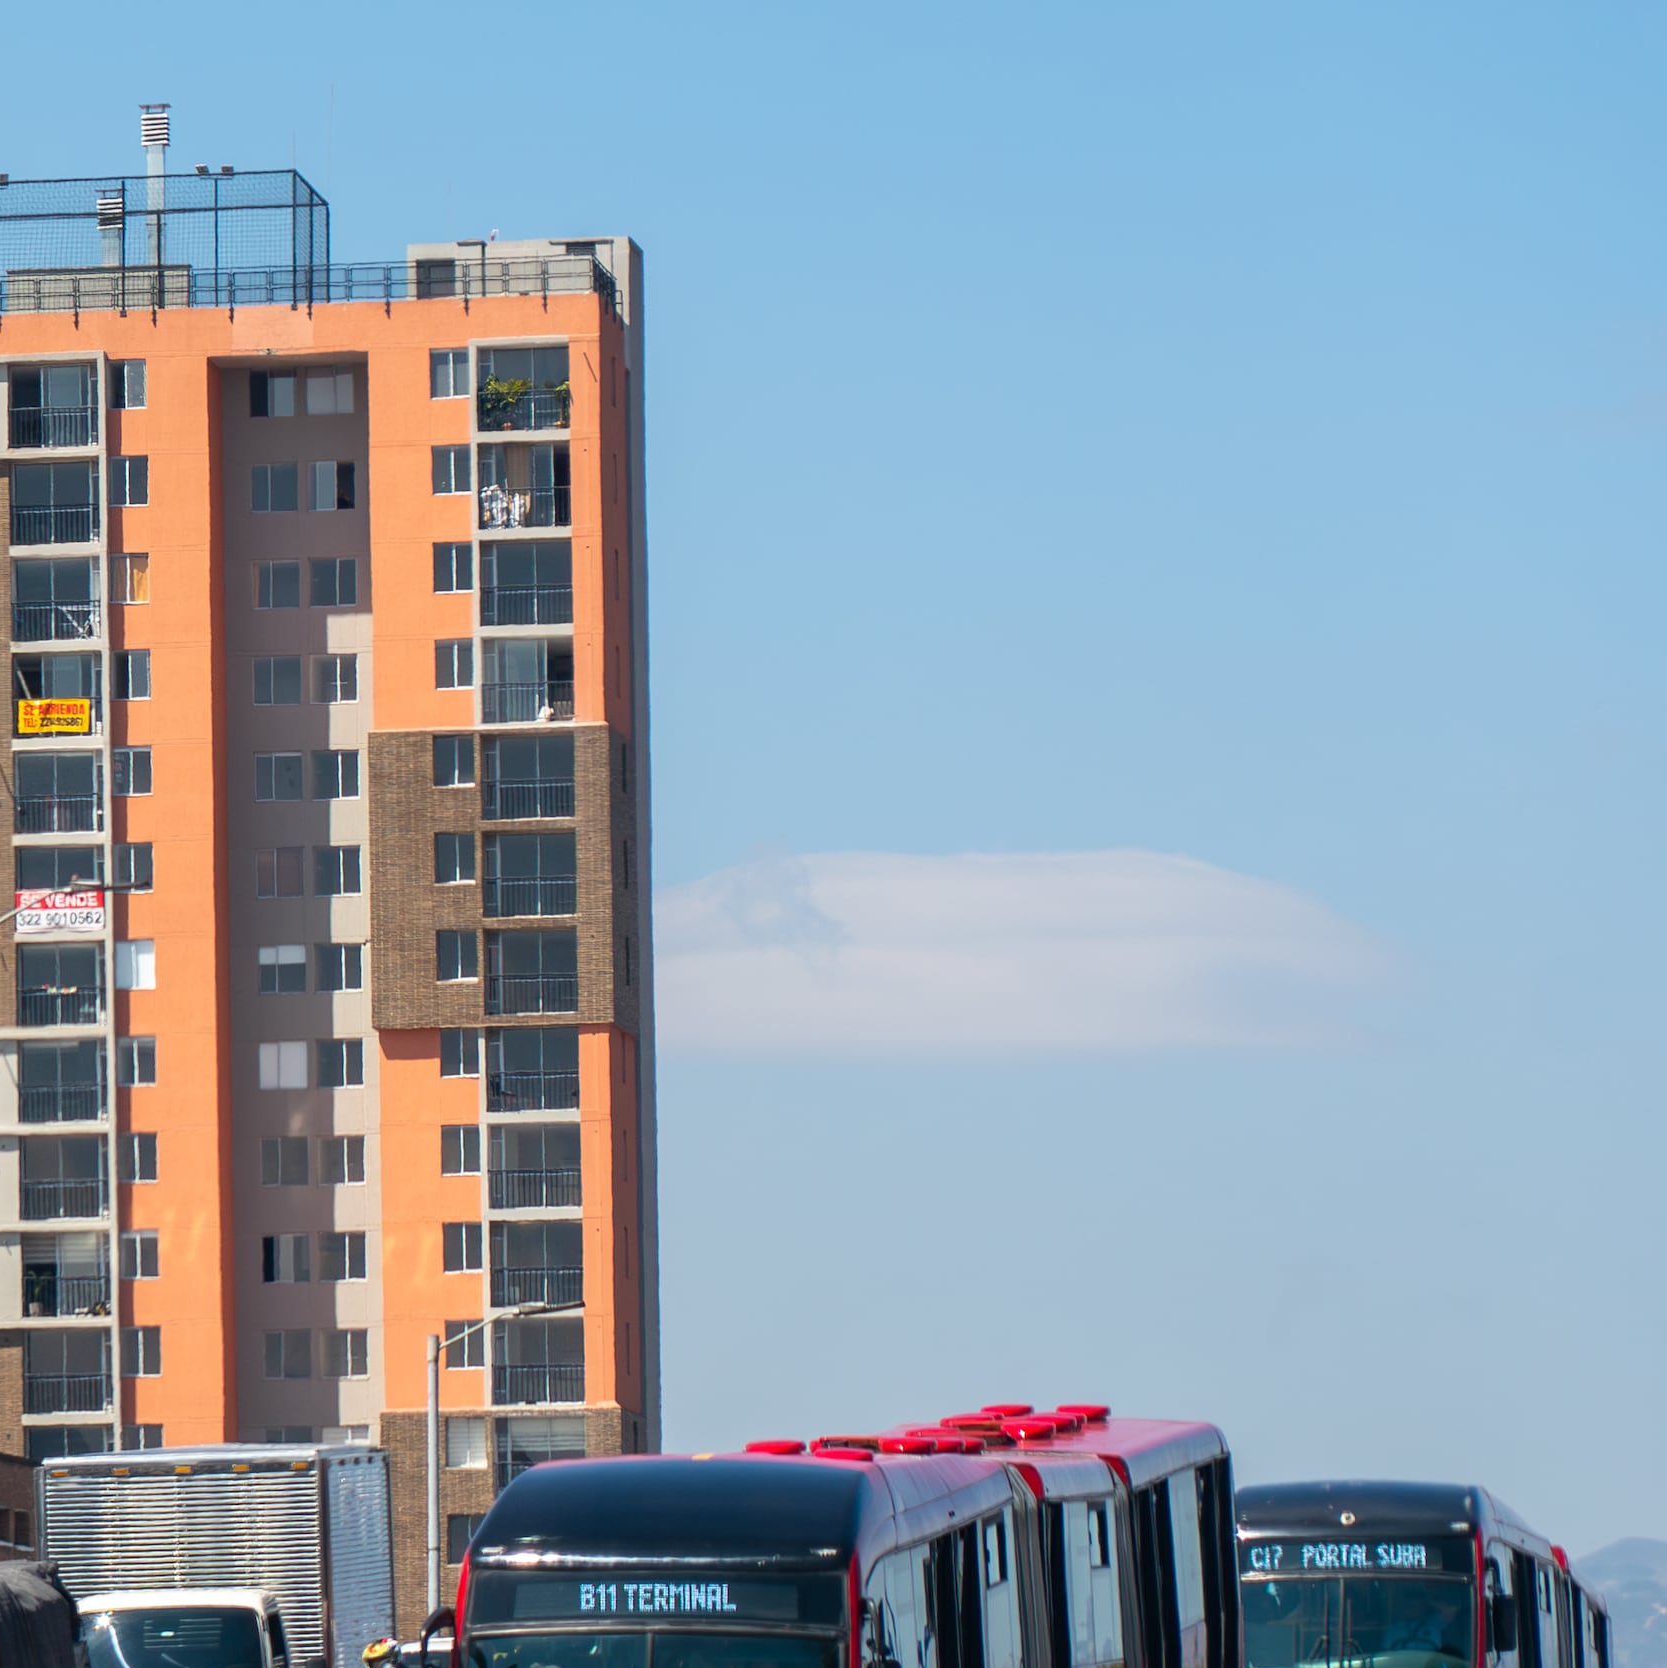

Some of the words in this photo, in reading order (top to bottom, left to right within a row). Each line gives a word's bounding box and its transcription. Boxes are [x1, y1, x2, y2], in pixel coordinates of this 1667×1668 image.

[49, 891, 98, 908] VENDE
[1302, 1542, 1372, 1569] PORTAL
[580, 1583, 617, 1611] B11
[624, 1583, 736, 1612] TERMINAL
